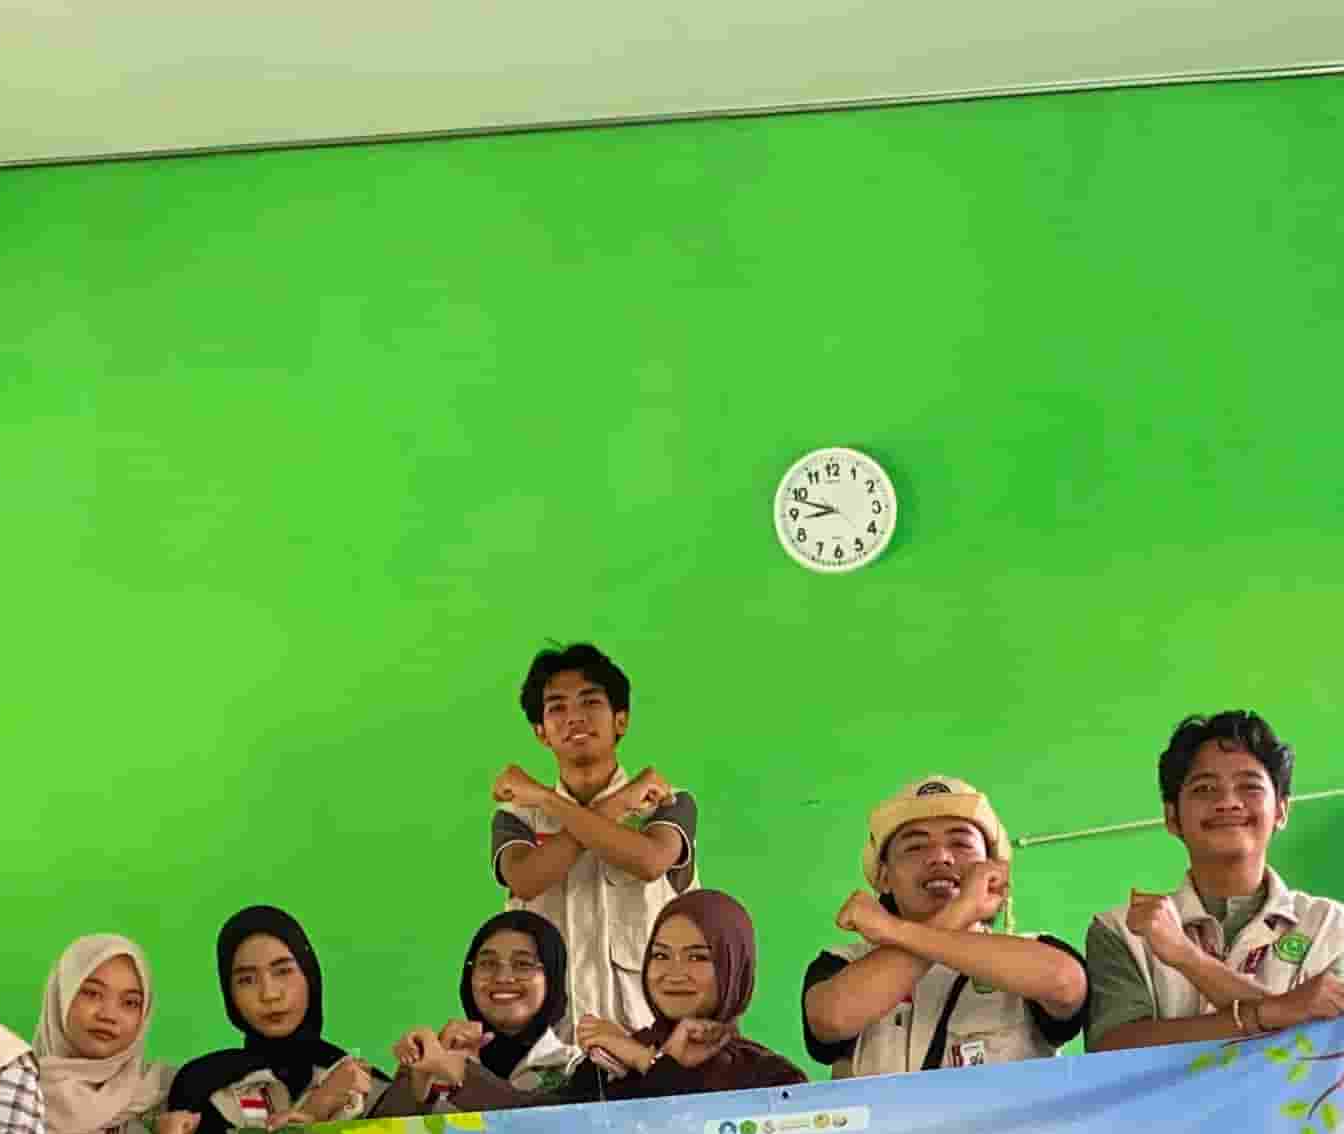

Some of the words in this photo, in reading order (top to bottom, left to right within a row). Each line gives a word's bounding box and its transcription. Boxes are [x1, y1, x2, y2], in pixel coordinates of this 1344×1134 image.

[825, 463, 840, 477] 12
[850, 467, 857, 480] 1
[808, 471, 819, 485] 11
[865, 479, 875, 493] 2
[792, 487, 808, 501] 10
[871, 500, 882, 514] 3
[789, 508, 799, 521] 9
[797, 527, 807, 542] 8
[866, 520, 877, 535] 4
[816, 541, 824, 556] 7
[834, 544, 844, 559] 6
[854, 537, 864, 552] 5
